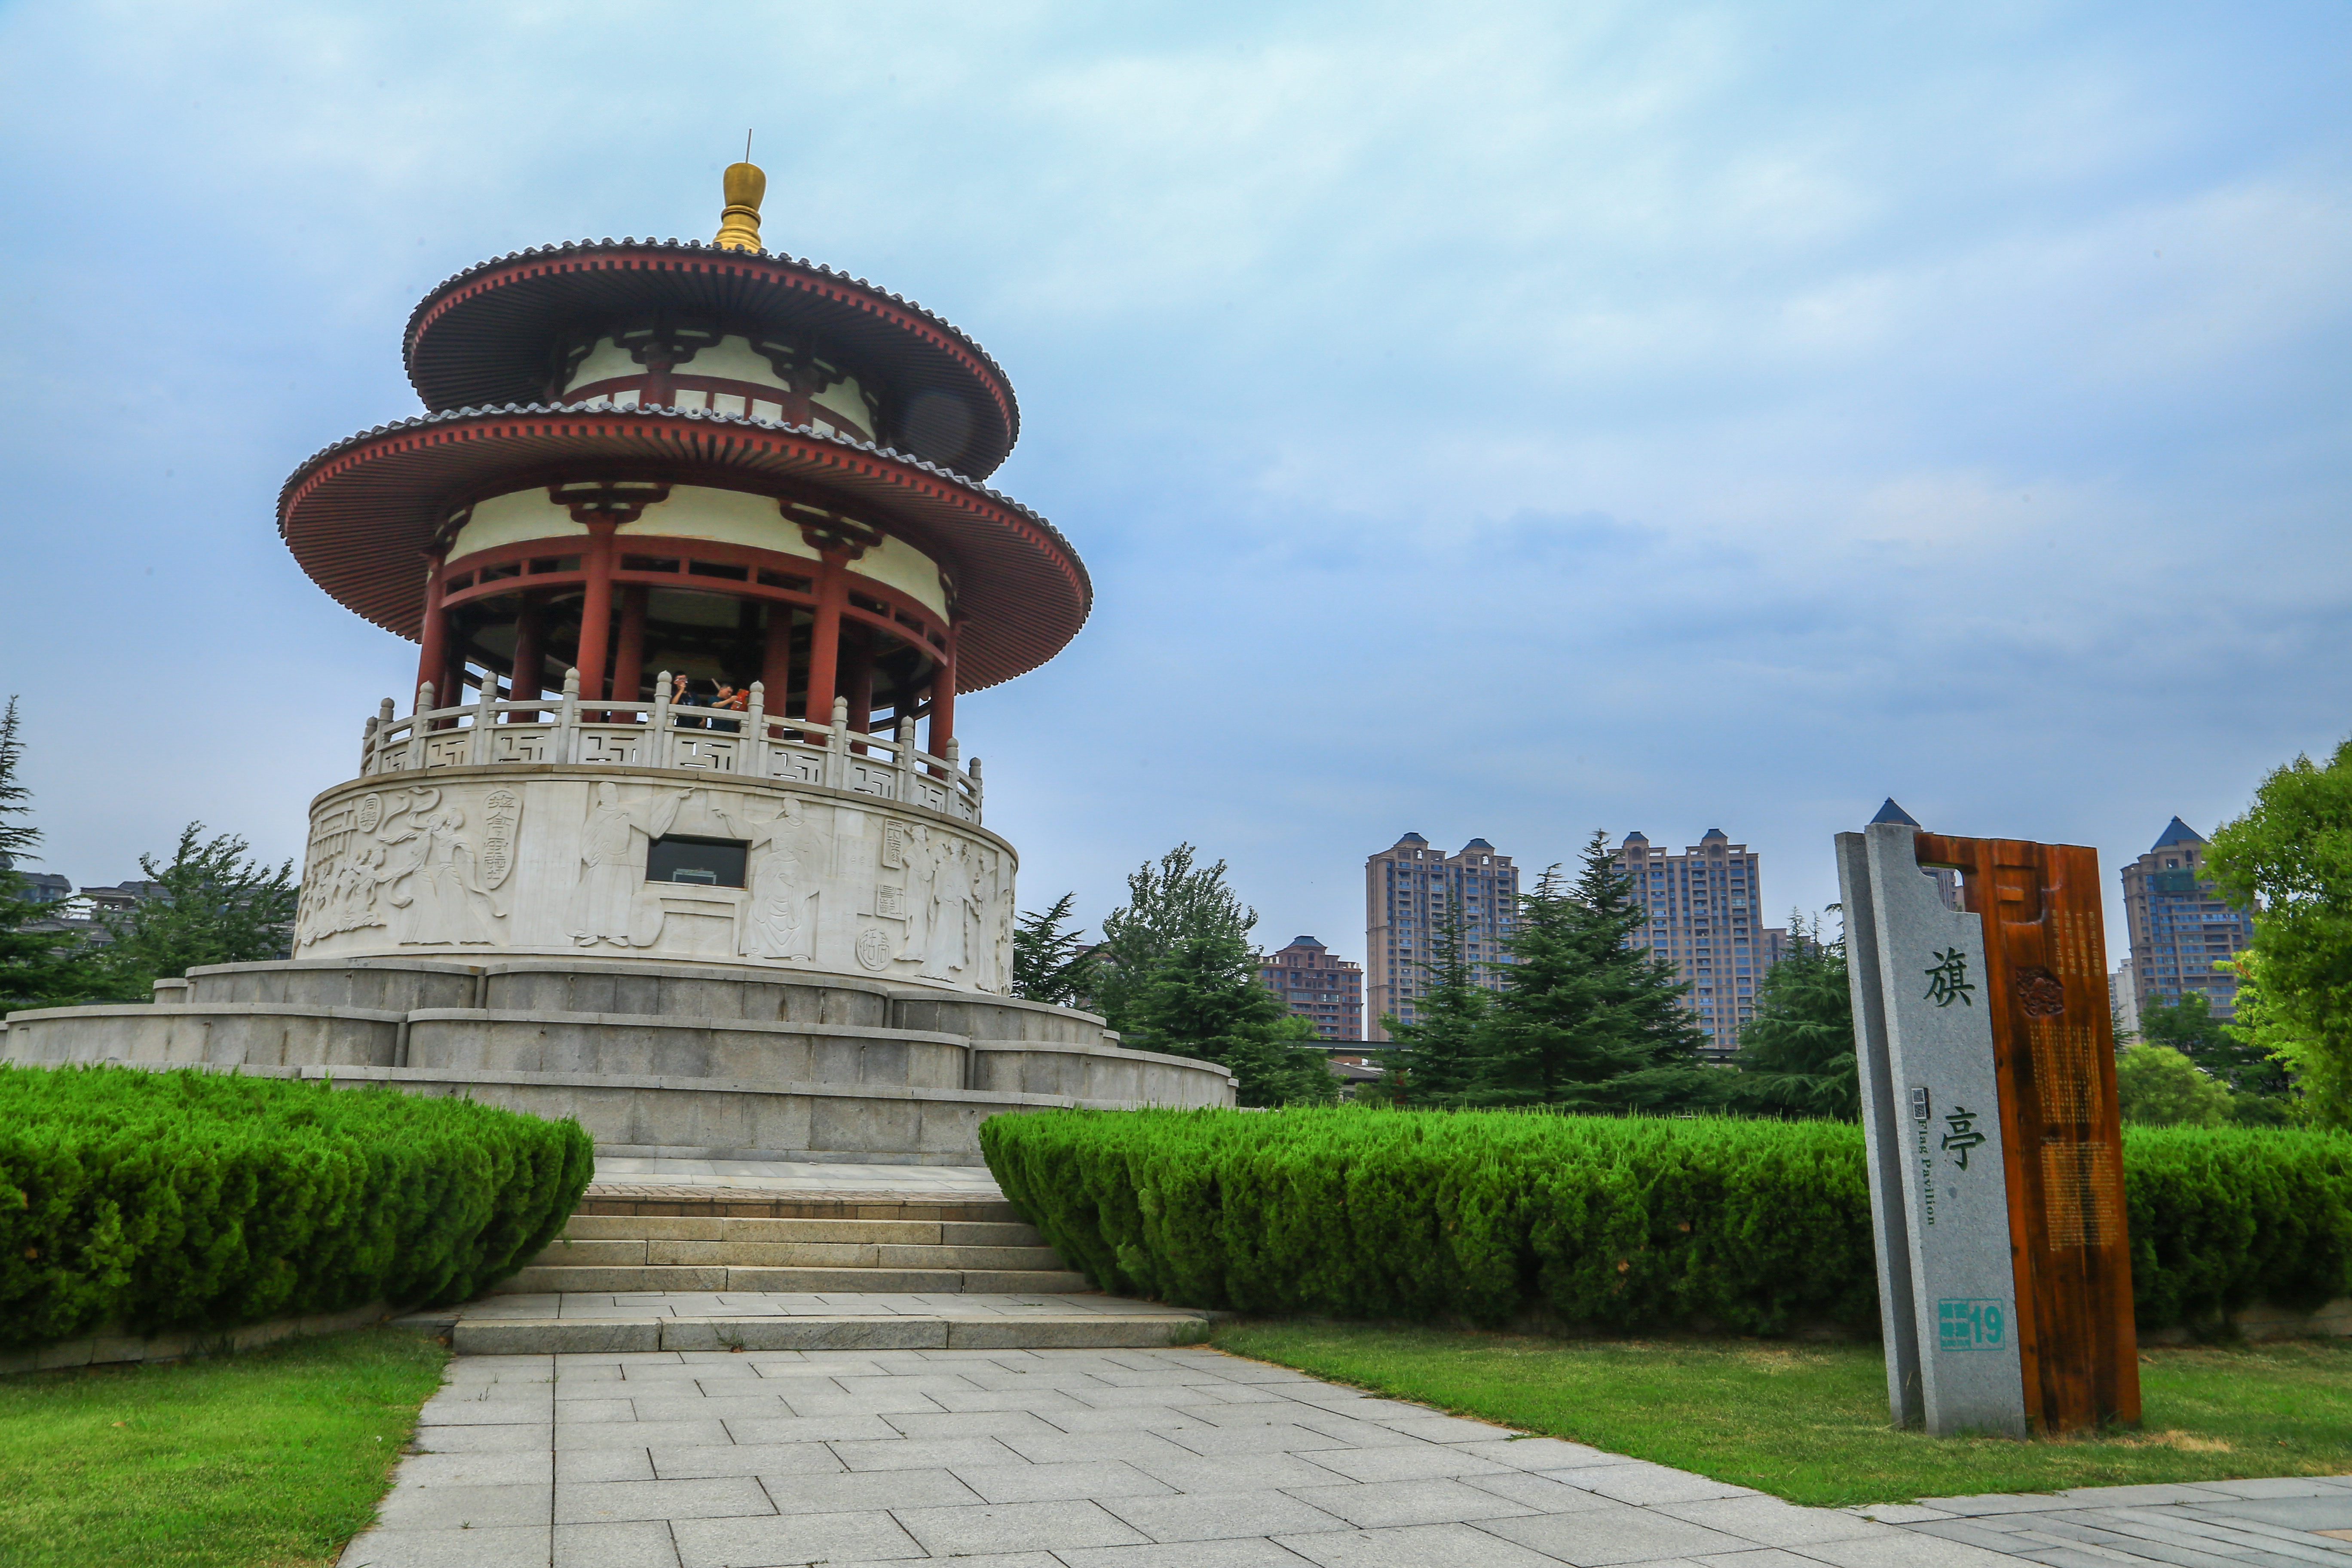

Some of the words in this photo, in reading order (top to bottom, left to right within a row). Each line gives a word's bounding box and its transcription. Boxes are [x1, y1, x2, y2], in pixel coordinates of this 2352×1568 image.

[1923, 946, 1986, 1171] 旗亭
[1918, 1120, 1928, 1154] Flag
[1922, 1158, 1935, 1225] Pavilion
[1970, 1305, 2001, 1343] 19
